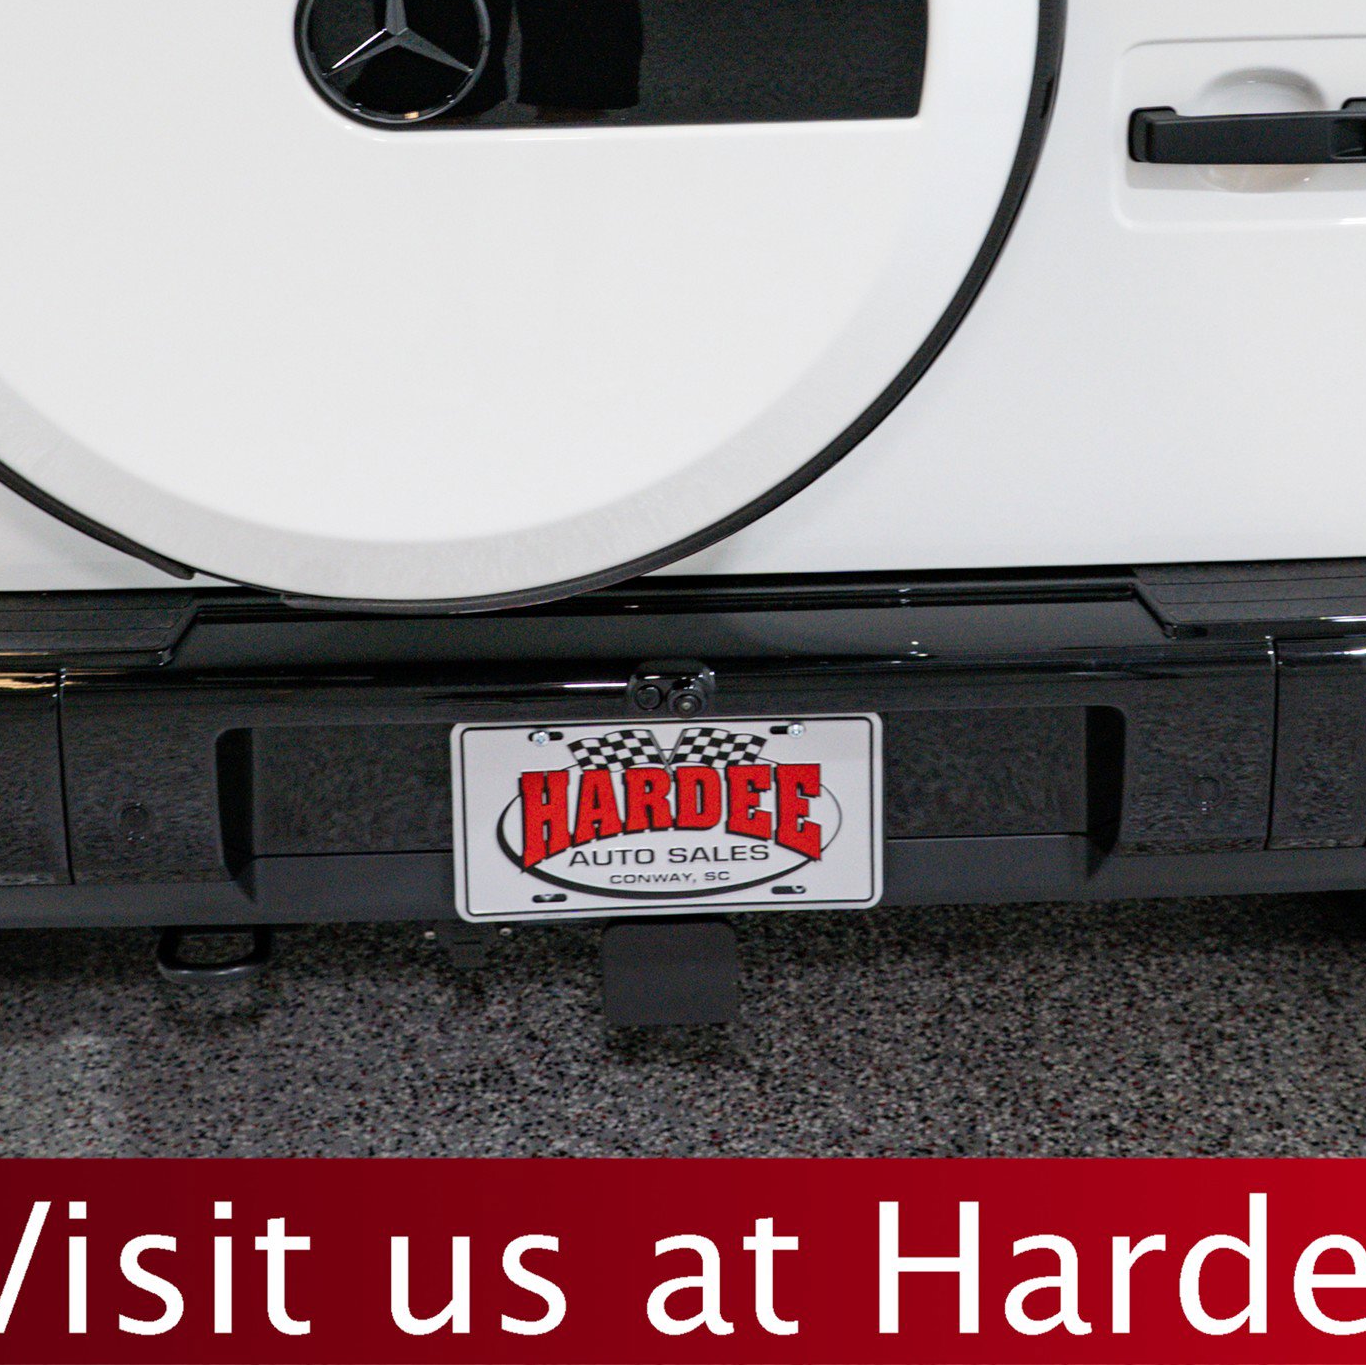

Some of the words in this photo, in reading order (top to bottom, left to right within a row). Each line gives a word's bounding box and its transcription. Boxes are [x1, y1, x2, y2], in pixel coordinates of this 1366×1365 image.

[520, 763, 822, 872] HARDEE
[569, 848, 655, 867] AUTO
[668, 844, 770, 864] SALES
[610, 872, 697, 884] CONWAY,
[704, 871, 731, 881] SC
